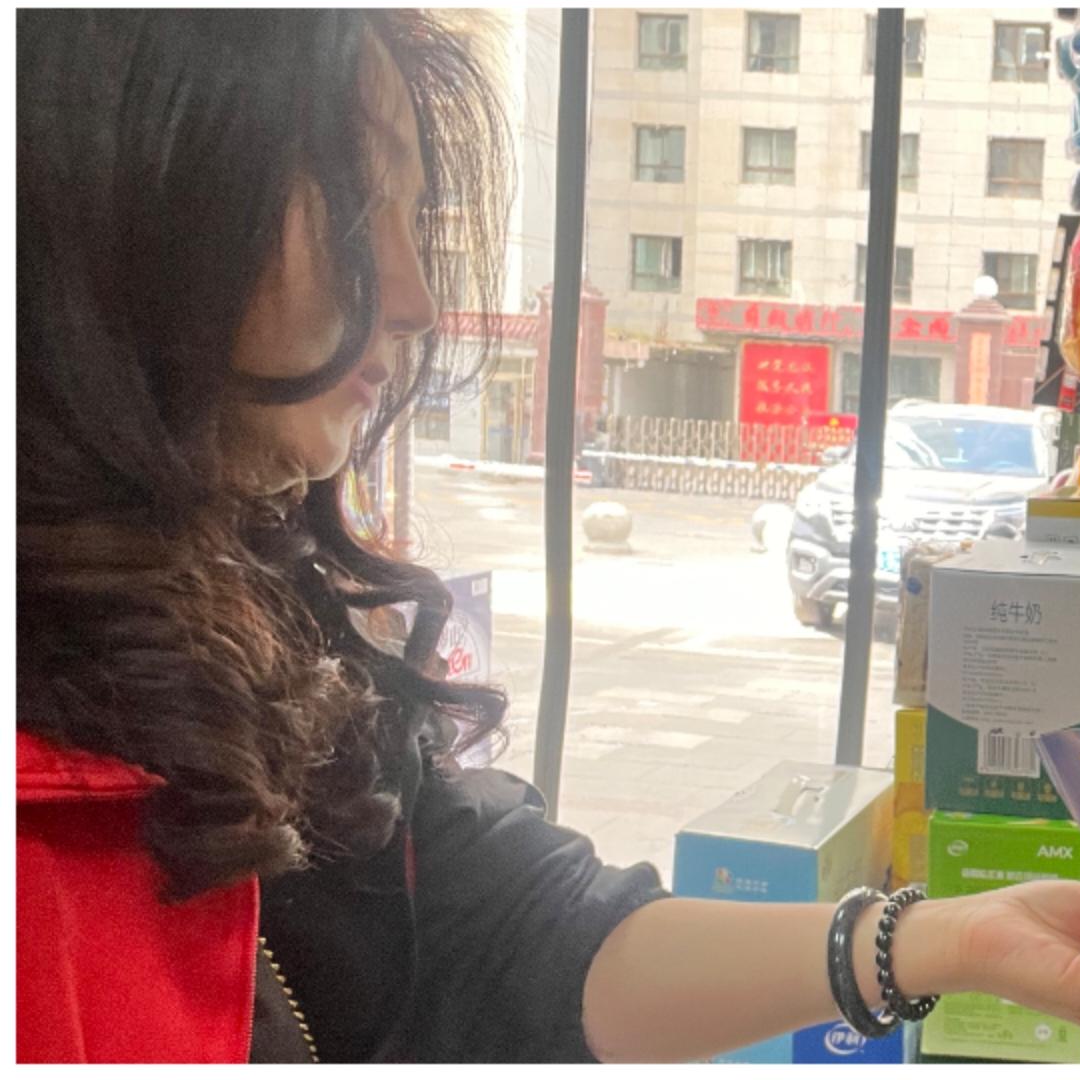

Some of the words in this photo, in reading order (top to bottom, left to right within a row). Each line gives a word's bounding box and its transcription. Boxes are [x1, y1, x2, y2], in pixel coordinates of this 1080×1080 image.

[990, 601, 1043, 626] 纯牛奶
[1037, 844, 1074, 860] AMX
